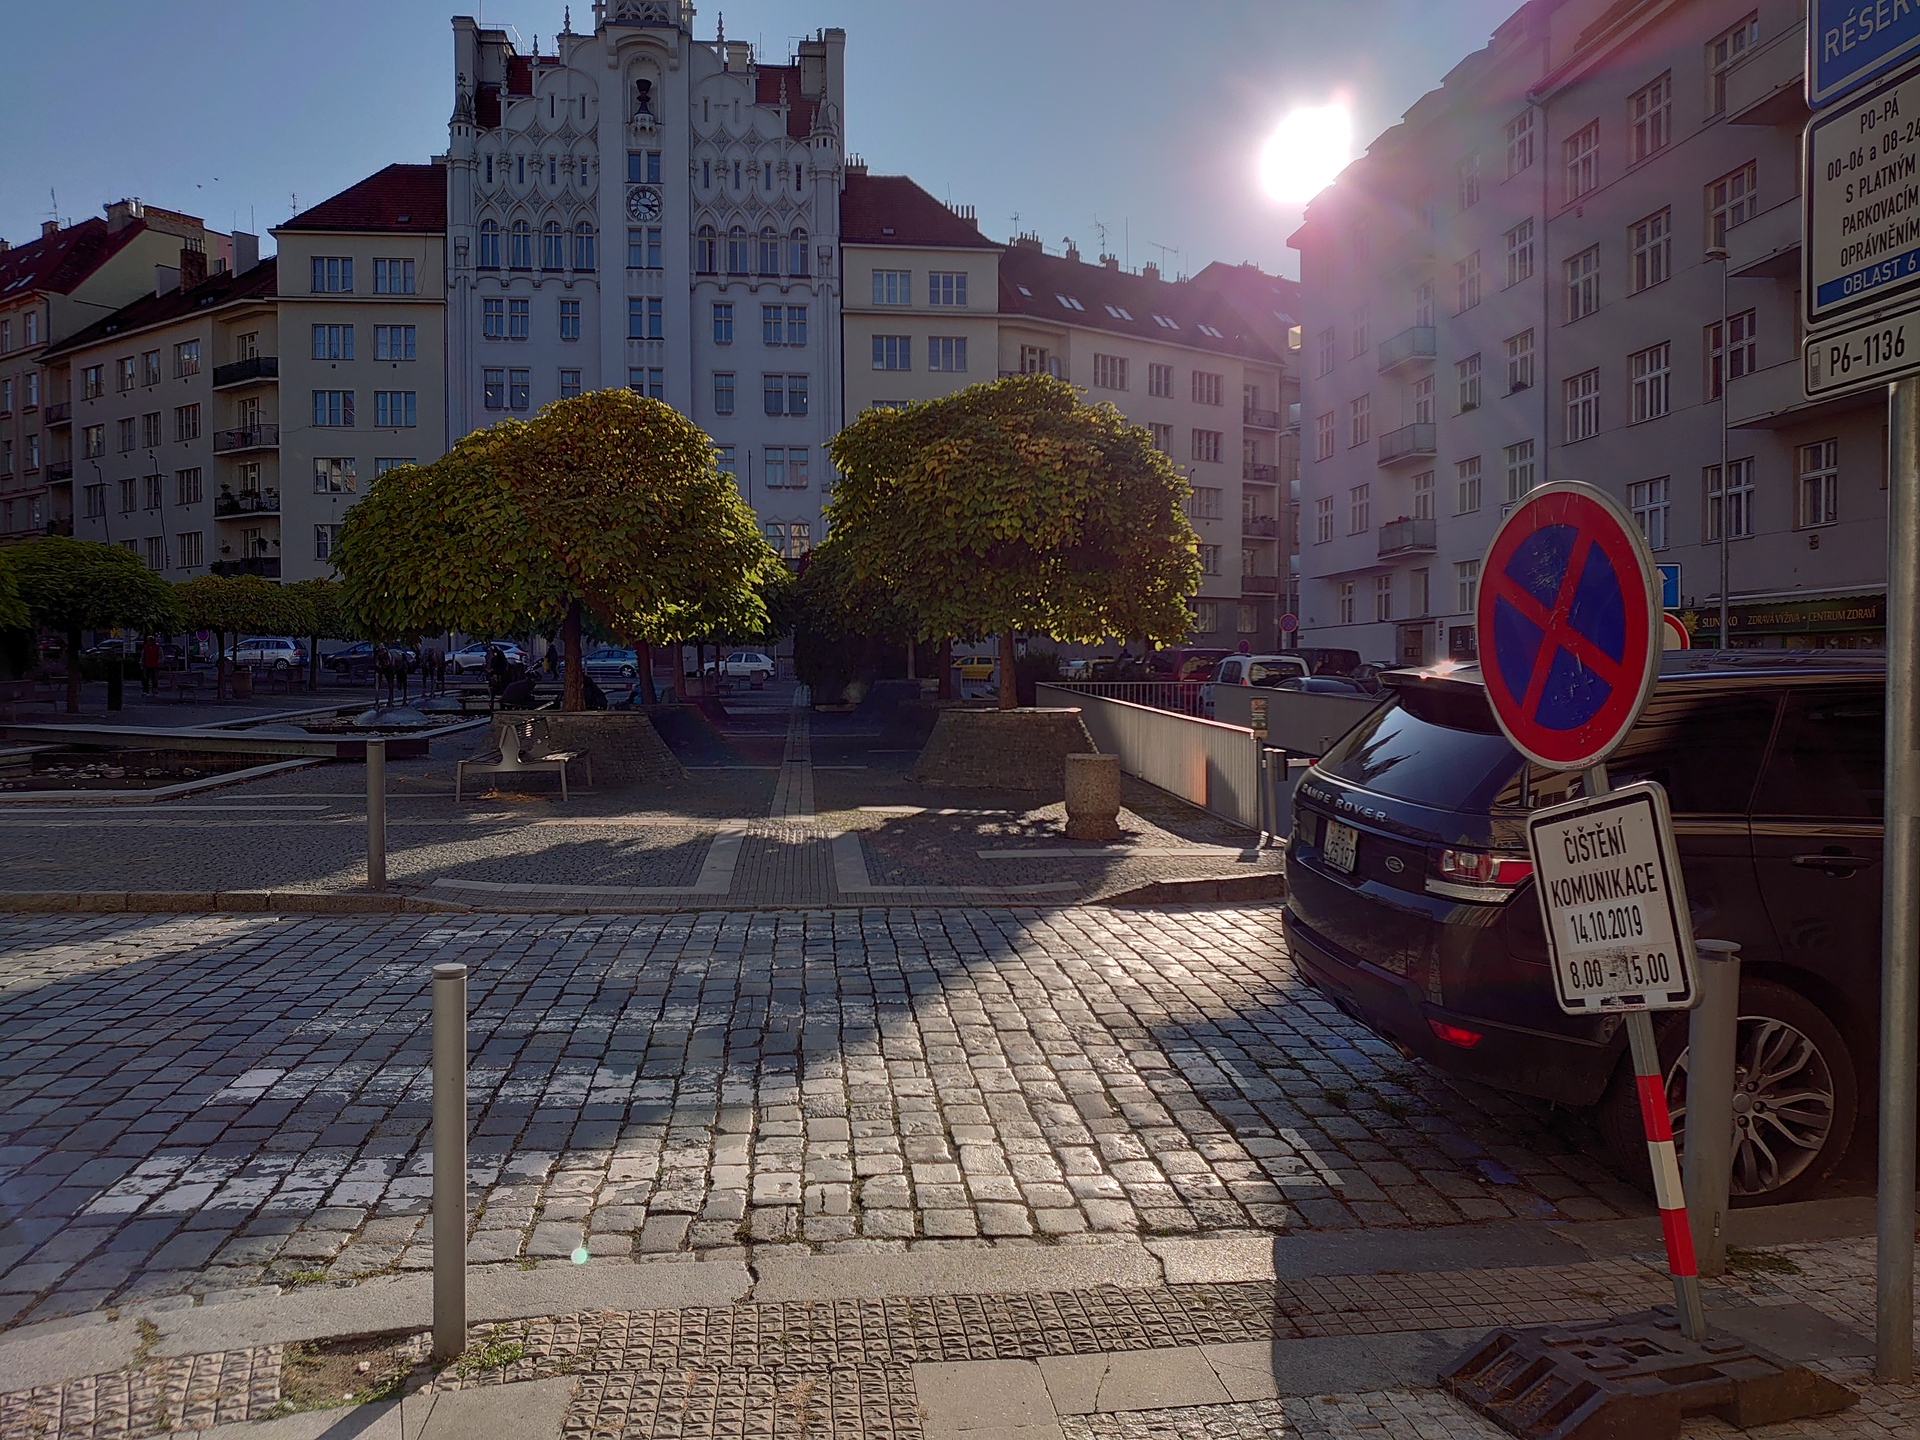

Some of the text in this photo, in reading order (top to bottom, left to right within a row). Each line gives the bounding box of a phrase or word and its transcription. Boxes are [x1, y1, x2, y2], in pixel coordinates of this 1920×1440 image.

[1824, 0, 1920, 63] RÉSER
[1860, 90, 1899, 134] PO-PÁ
[1827, 147, 1864, 181] 00-06
[1870, 145, 1877, 161] a
[1845, 153, 1916, 203] S PLATNÝM
[1842, 184, 1919, 236] PARKOVACÍM
[1841, 217, 1920, 267] OPRÁVNĚNÍM
[1843, 256, 1917, 295] OBLAST 6
[1830, 325, 1905, 376] P6-1136
[1747, 612, 1775, 625] ZDRAVÁ
[1809, 609, 1846, 621] CENTRUM
[1846, 605, 1876, 619] ZDRAVÍ
[1301, 783, 1387, 821] RANGE ROVER
[1562, 817, 1627, 865] ČIŠTĚNÍ
[1550, 862, 1658, 908] KOMUNIKACE
[1570, 904, 1644, 944] 14.10.2019
